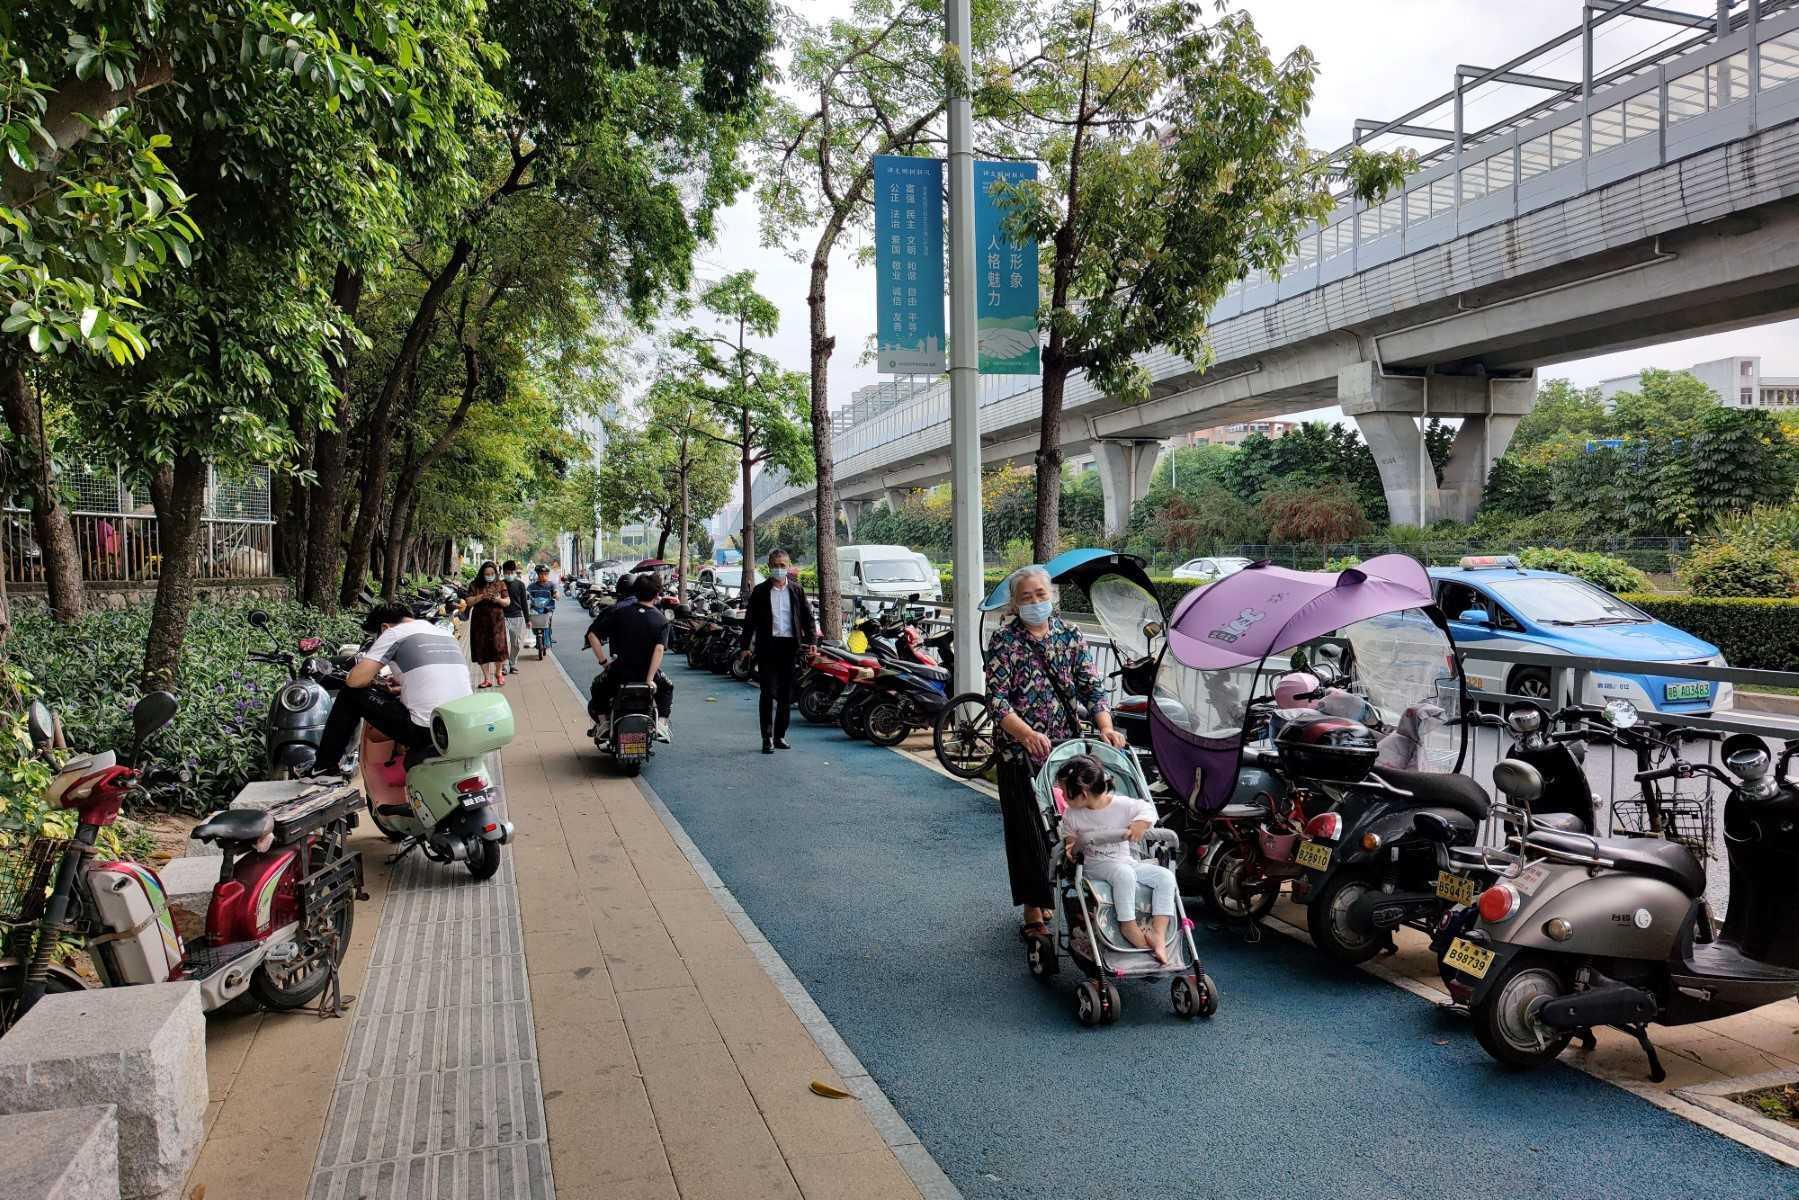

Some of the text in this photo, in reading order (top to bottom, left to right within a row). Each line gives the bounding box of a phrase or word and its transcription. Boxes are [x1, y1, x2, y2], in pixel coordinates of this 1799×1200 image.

[889, 183, 901, 203] 公正
[987, 233, 1001, 307] 人格魅力
[1449, 948, 1486, 971] B98739
